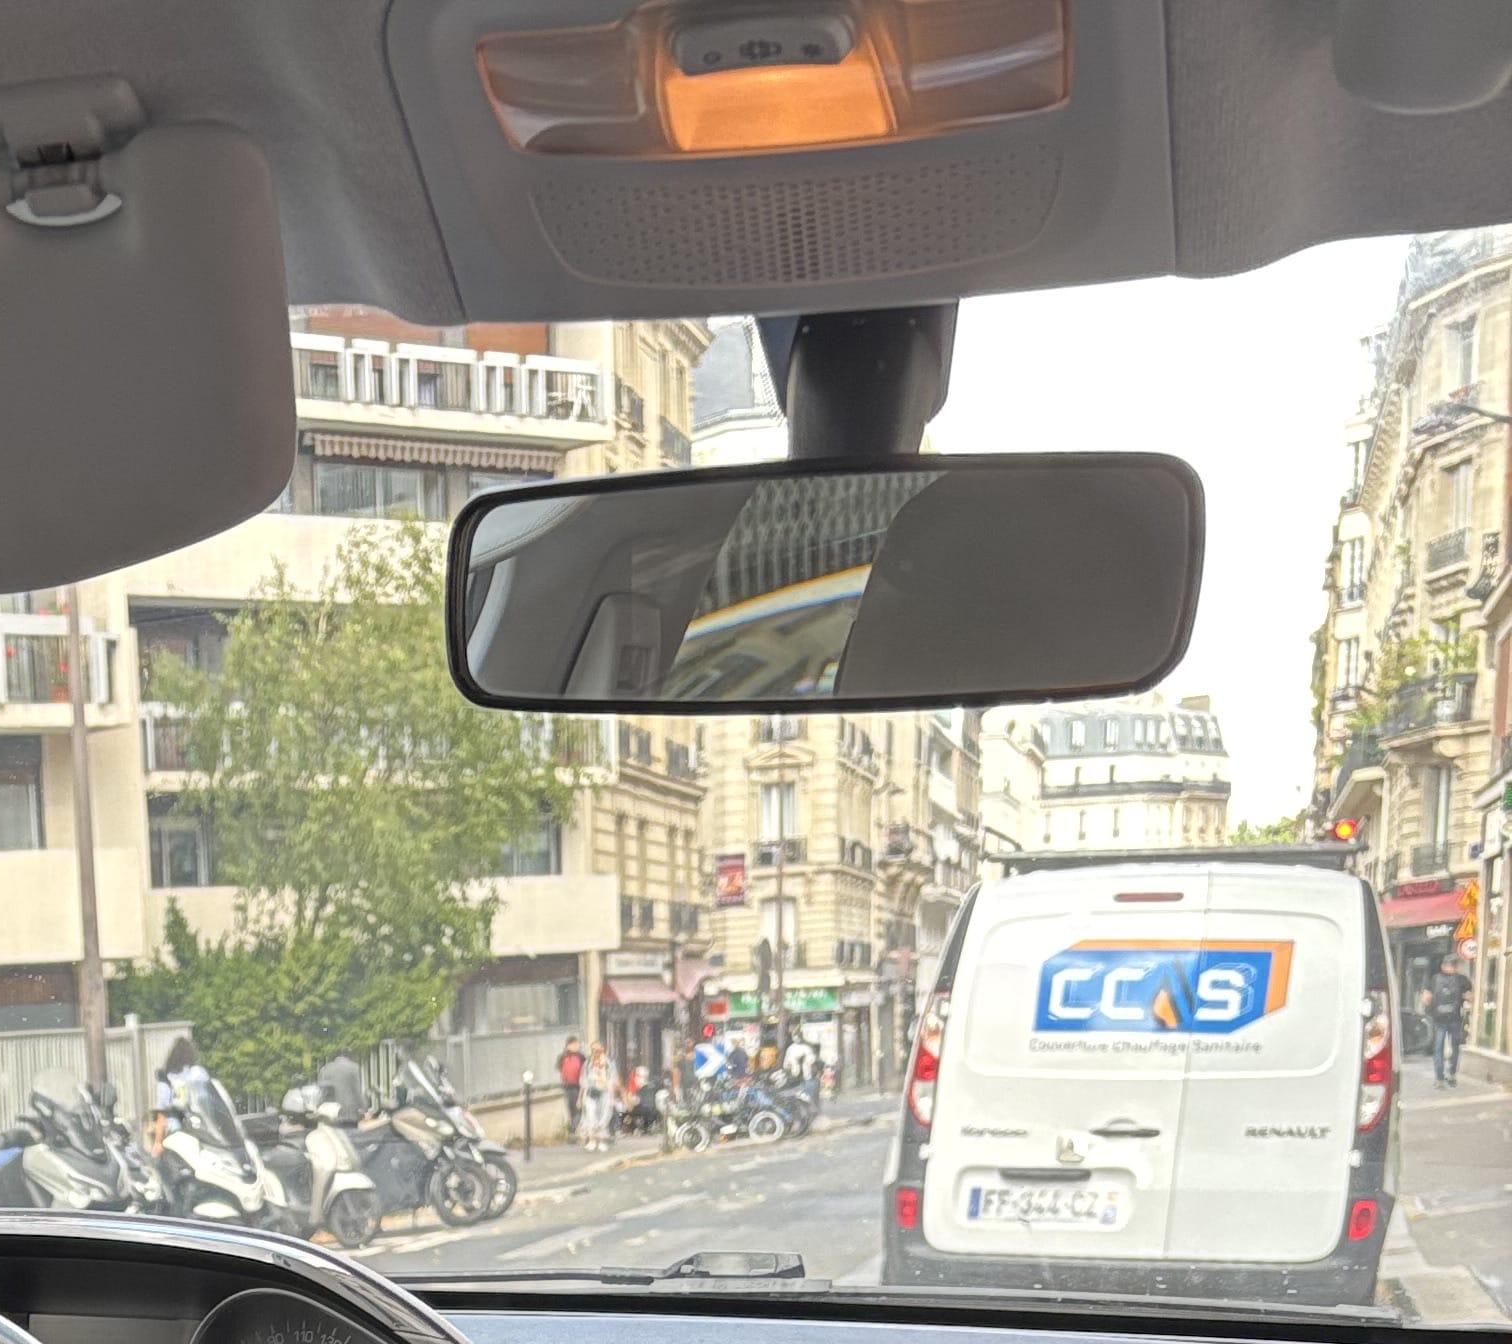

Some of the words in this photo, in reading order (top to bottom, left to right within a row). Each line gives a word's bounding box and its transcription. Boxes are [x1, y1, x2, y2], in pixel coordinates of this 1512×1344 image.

[1048, 963, 1256, 1027] CCAS
[1191, 1039, 1263, 1054] Sanitaire
[1244, 1126, 1331, 1138] RENAULT
[294, 1330, 314, 1343] 110
